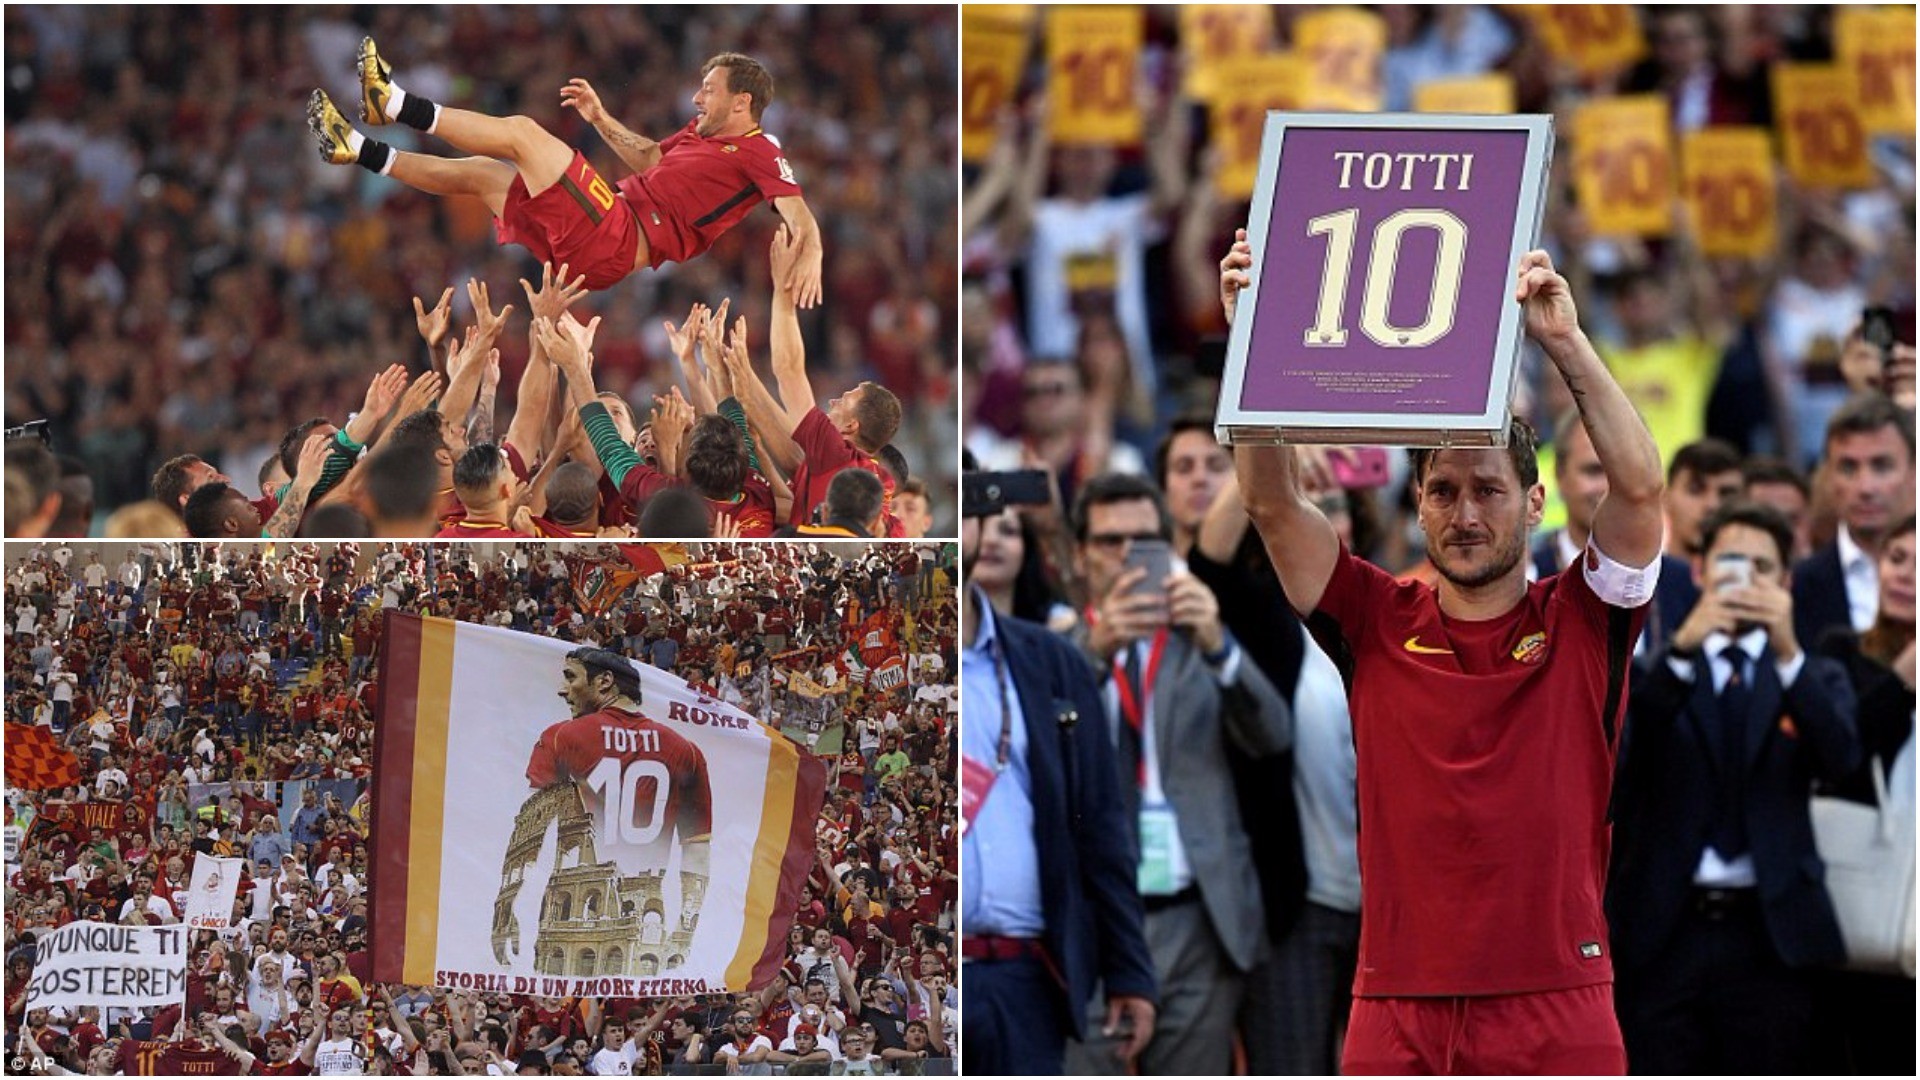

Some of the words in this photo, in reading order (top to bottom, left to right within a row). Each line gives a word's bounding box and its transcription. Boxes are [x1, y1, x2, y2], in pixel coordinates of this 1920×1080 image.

[1334, 152, 1474, 190] TOTTI
[1304, 208, 1468, 347] 10
[601, 726, 660, 752] TOTTI
[84, 805, 117, 829] VIALE
[587, 757, 670, 845] 10
[35, 928, 139, 967] OVUNQUE
[153, 928, 179, 955] TI
[28, 967, 185, 1003] SOSTERREM
[436, 970, 507, 992] STORIA
[514, 975, 537, 994] DI
[542, 978, 569, 996] UN
[571, 979, 634, 996] AMORE
[182, 1061, 214, 1073] TOTTI
